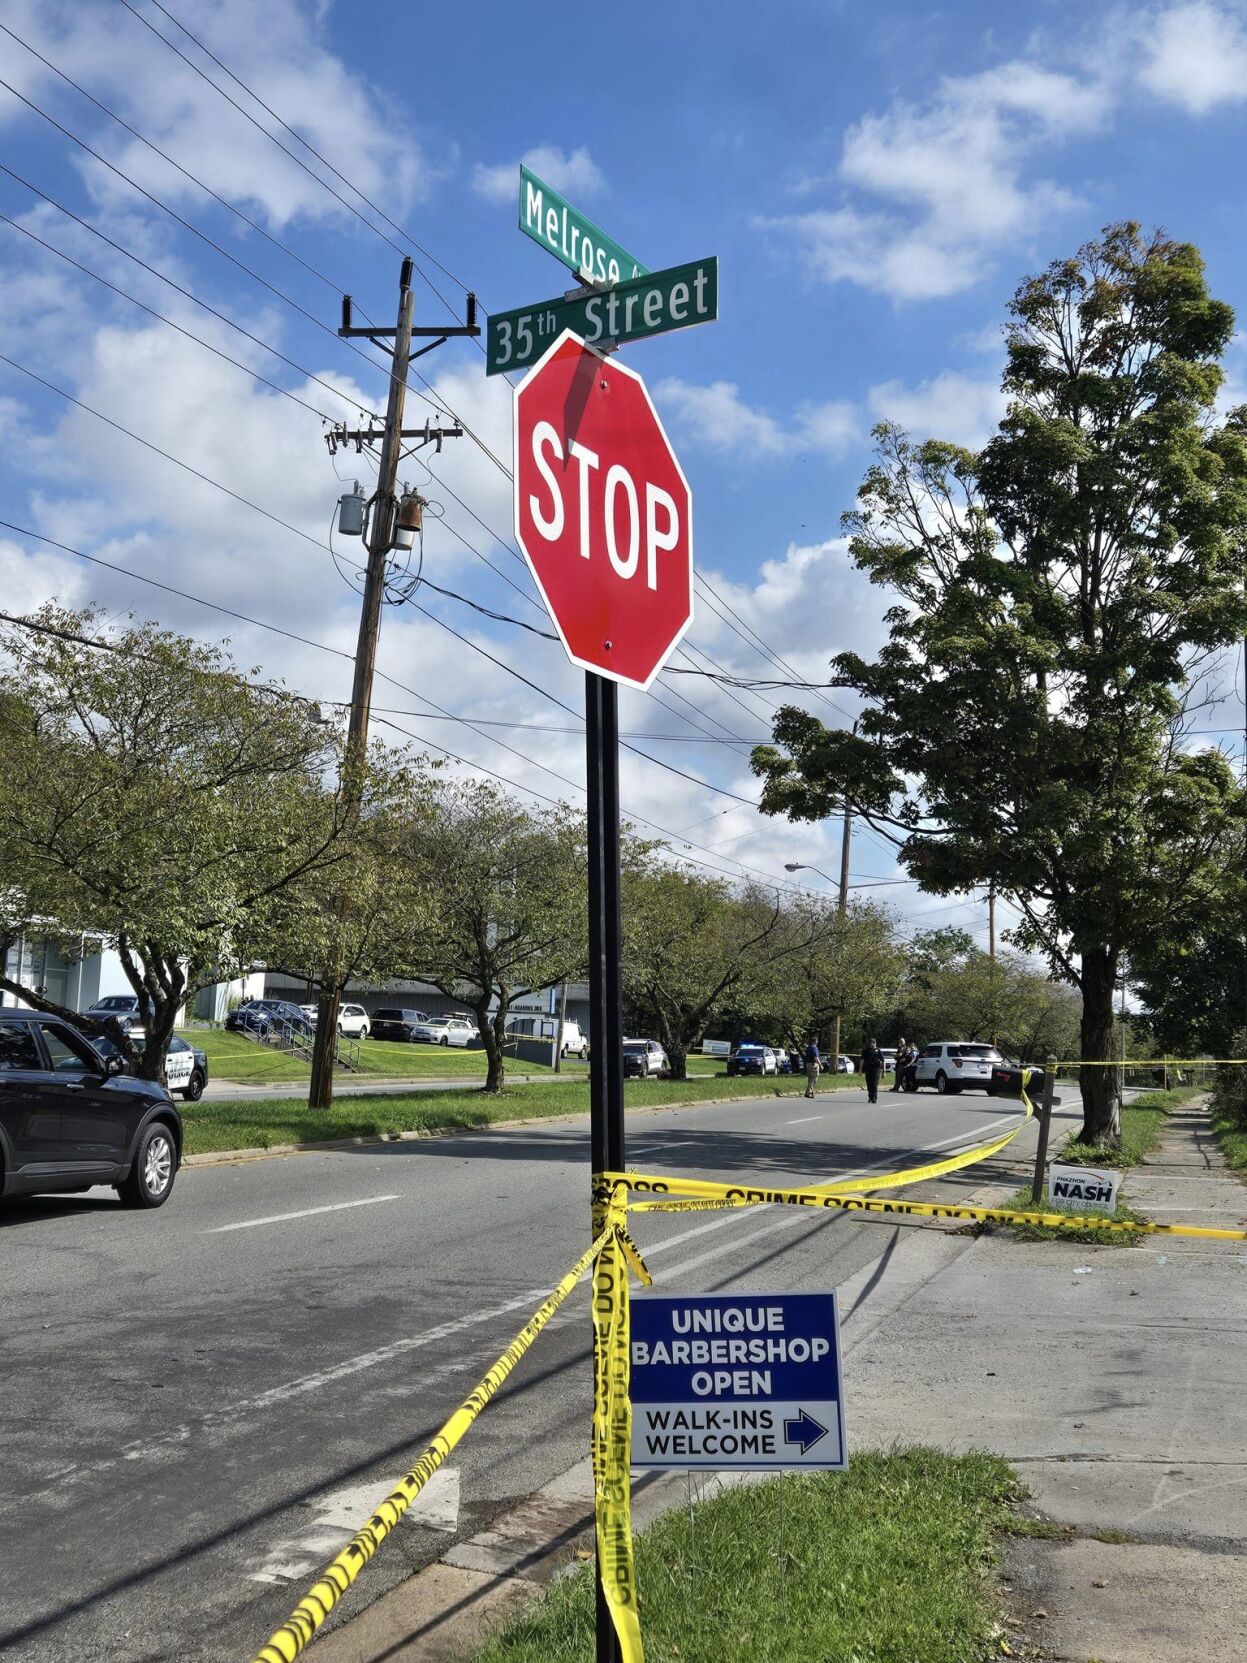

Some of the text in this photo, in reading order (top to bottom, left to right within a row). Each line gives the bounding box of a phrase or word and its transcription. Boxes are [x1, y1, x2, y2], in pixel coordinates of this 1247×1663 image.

[526, 181, 620, 284] Melrose
[495, 268, 708, 365] 35th Street
[529, 420, 680, 592] STOP
[1053, 1182, 1113, 1202] NASH
[671, 1307, 785, 1333] UNIQUE
[631, 1337, 830, 1366] BARBERSHOP
[691, 1370, 772, 1396] OPEN
[646, 1409, 774, 1431] WALK-INS
[646, 1434, 776, 1455] WELCOME
